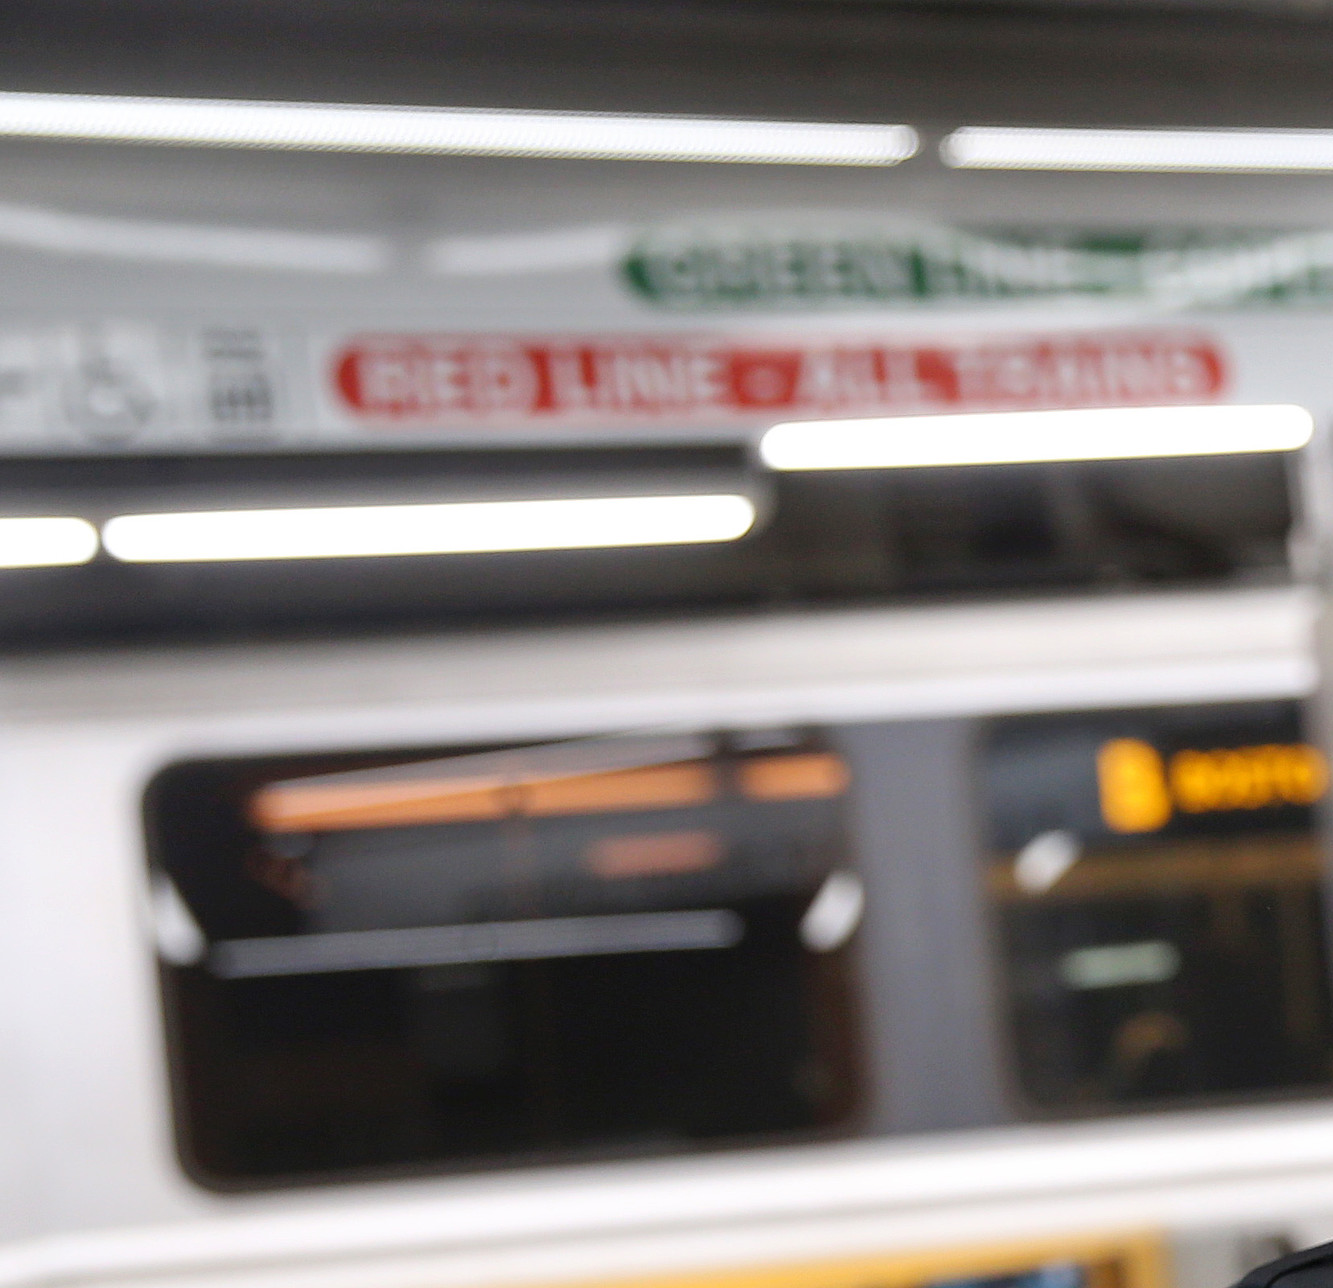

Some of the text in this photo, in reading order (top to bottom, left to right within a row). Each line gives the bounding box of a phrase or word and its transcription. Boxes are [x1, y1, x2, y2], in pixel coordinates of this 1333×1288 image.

[362, 336, 1206, 410] RED LINE ALL TRAINS
[1097, 738, 1171, 834] B
